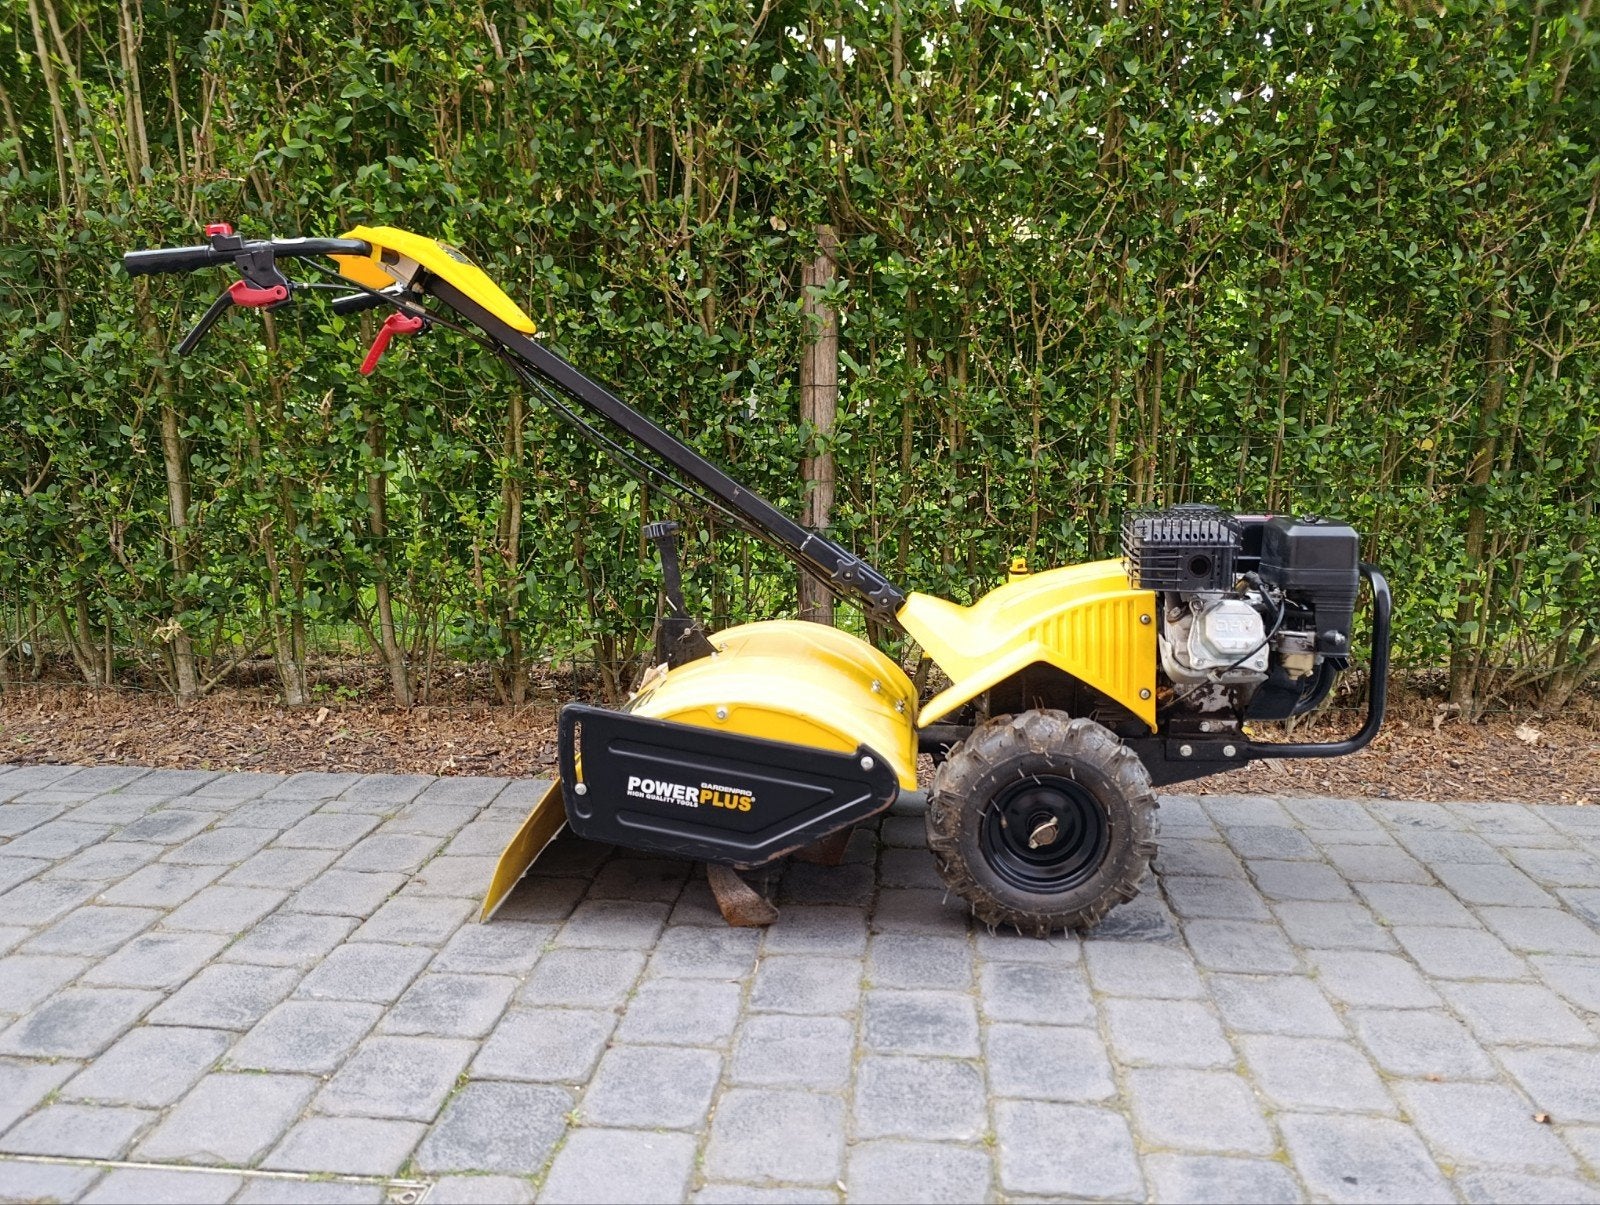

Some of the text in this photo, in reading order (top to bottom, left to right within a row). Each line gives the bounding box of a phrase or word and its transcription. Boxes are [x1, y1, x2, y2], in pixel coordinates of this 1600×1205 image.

[700, 782, 752, 797] GARDENPRO
[627, 790, 699, 808] HIGH QUALITY TOOLS
